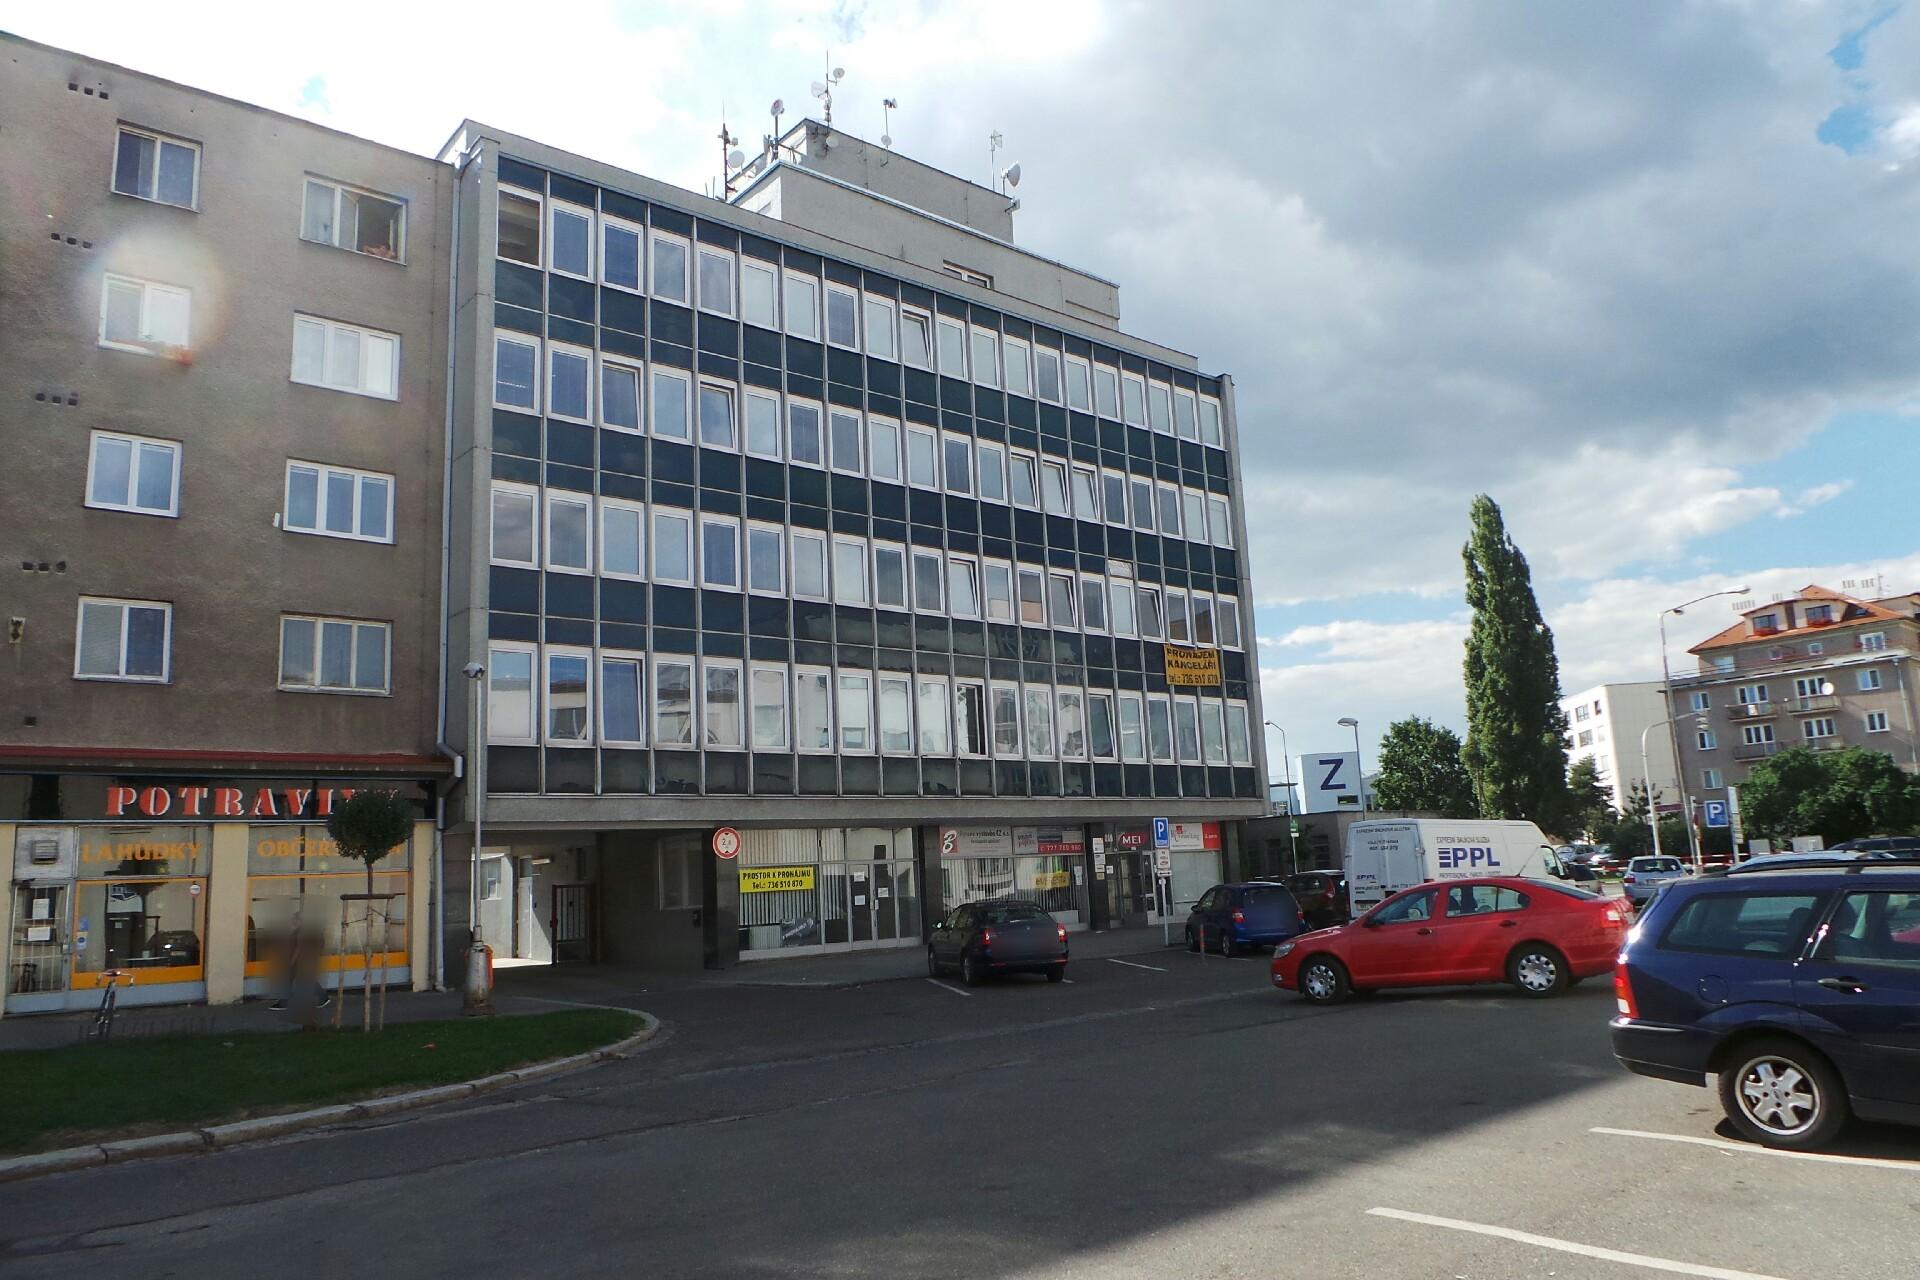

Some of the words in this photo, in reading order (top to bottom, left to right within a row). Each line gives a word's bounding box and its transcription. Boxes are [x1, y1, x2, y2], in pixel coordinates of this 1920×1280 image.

[1319, 758, 1346, 790] Z
[105, 784, 399, 817] POTRAVI
[1709, 803, 1723, 819] P
[1157, 821, 1165, 838] P
[1122, 835, 1141, 845] MEI
[1452, 847, 1501, 867] PPL
[742, 871, 771, 880] PROSTOR
[777, 869, 811, 878] PRONÁJMU
[768, 881, 779, 889] 736
[779, 880, 790, 888] 510
